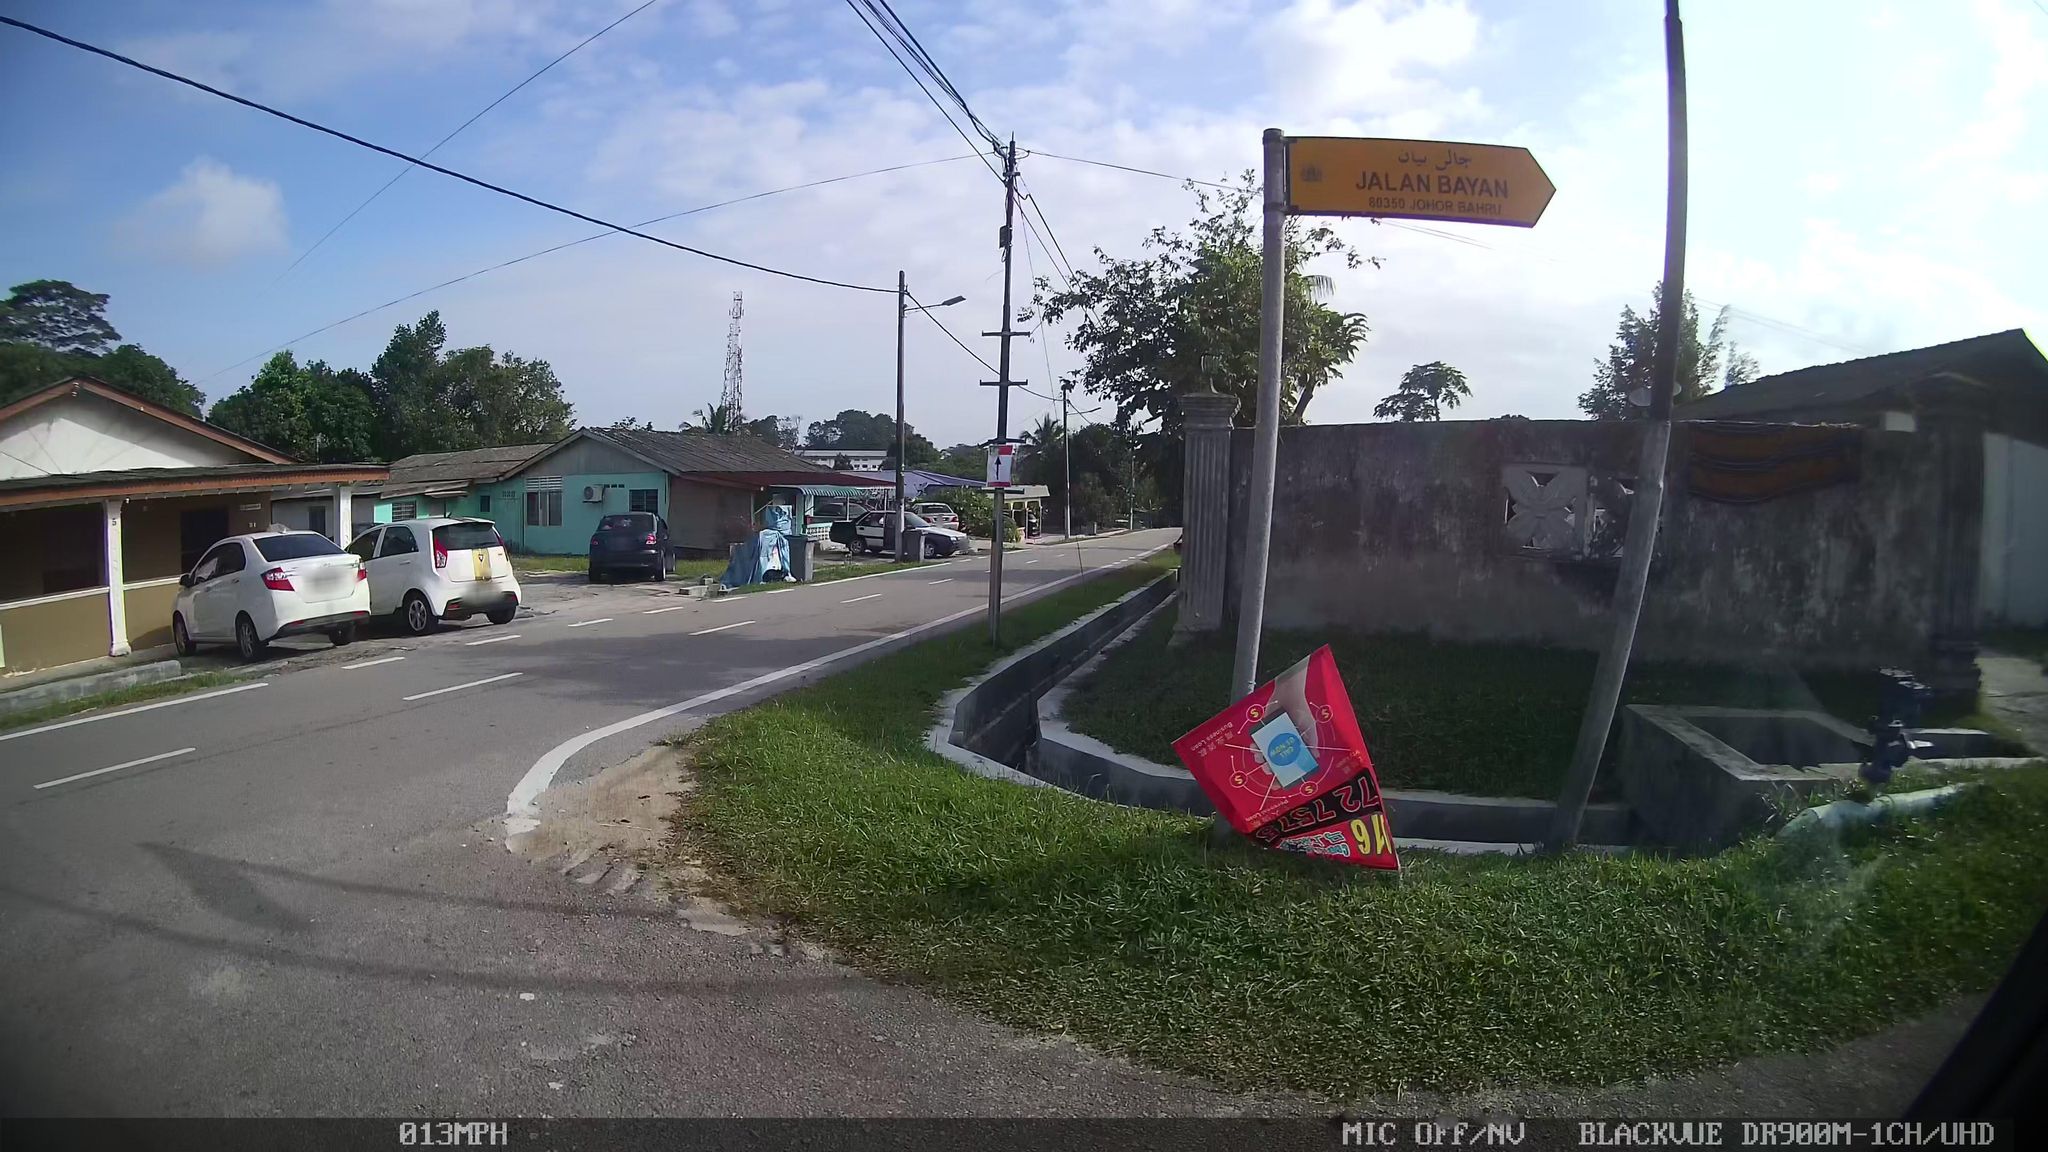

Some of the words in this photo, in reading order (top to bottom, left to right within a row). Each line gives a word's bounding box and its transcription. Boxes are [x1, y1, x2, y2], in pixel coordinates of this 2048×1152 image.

[1356, 171, 1430, 193] JALAN
[1438, 175, 1509, 199] BAYAN
[1409, 199, 1453, 215] JOHOR
[1458, 201, 1502, 217] BAHRU
